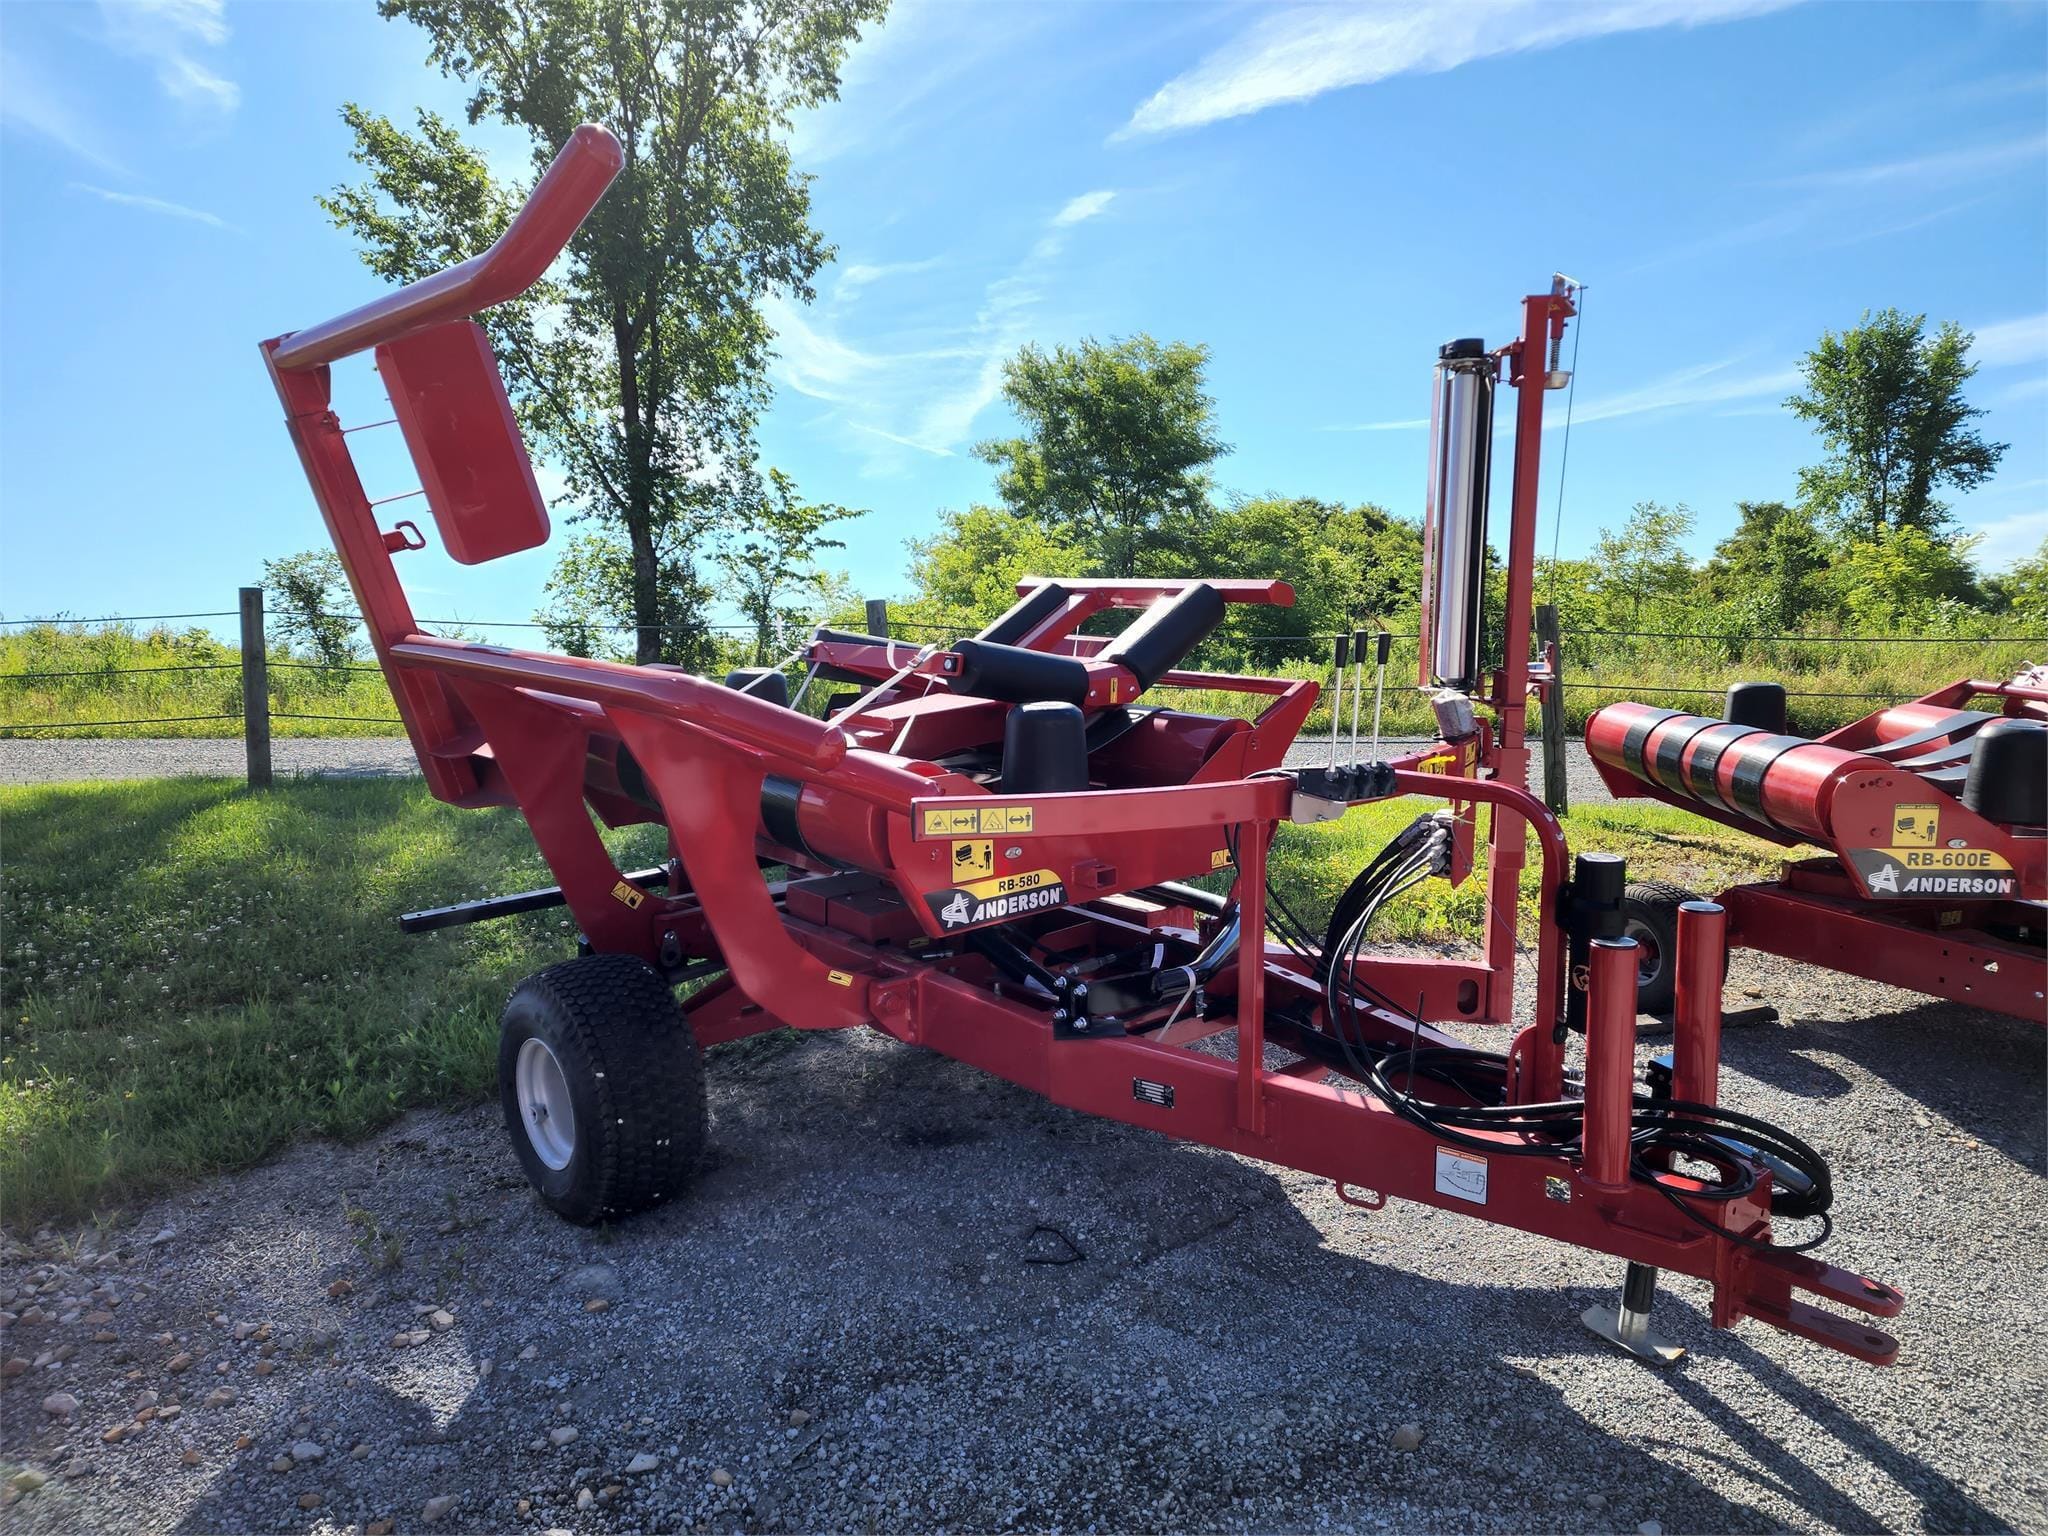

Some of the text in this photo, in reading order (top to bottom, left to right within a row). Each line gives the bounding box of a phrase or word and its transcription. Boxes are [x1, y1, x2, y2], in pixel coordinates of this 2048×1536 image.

[1907, 852, 1991, 867] RB-600E
[998, 873, 1040, 893] RB-580
[1902, 877, 2012, 894] ANDERSON
[971, 888, 1061, 922] ANDERSON
